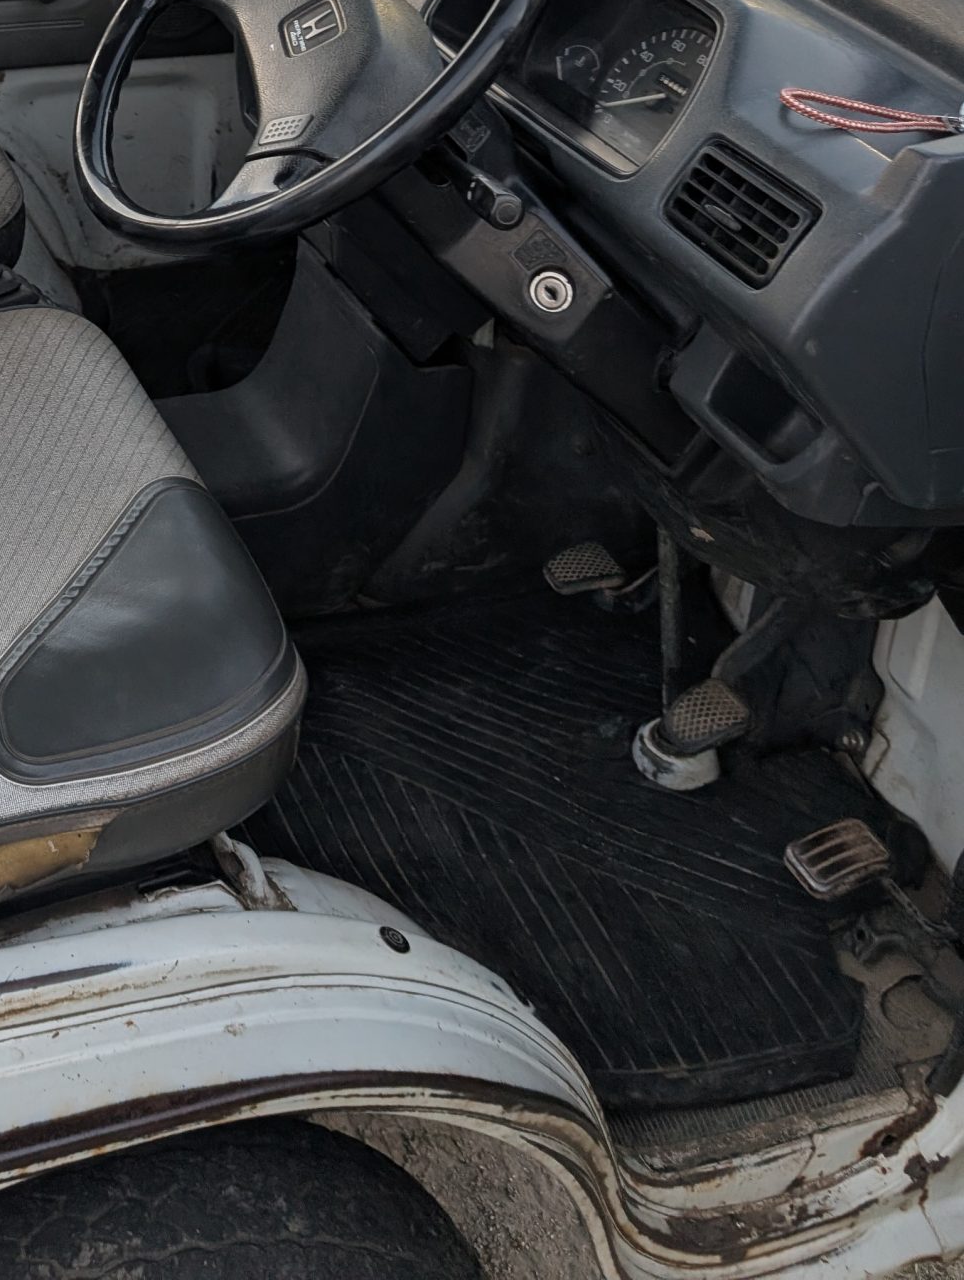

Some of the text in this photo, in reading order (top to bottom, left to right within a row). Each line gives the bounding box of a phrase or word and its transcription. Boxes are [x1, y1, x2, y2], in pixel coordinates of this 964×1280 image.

[671, 40, 686, 52] 60
[640, 51, 654, 62] 40
[613, 80, 627, 91] 20
